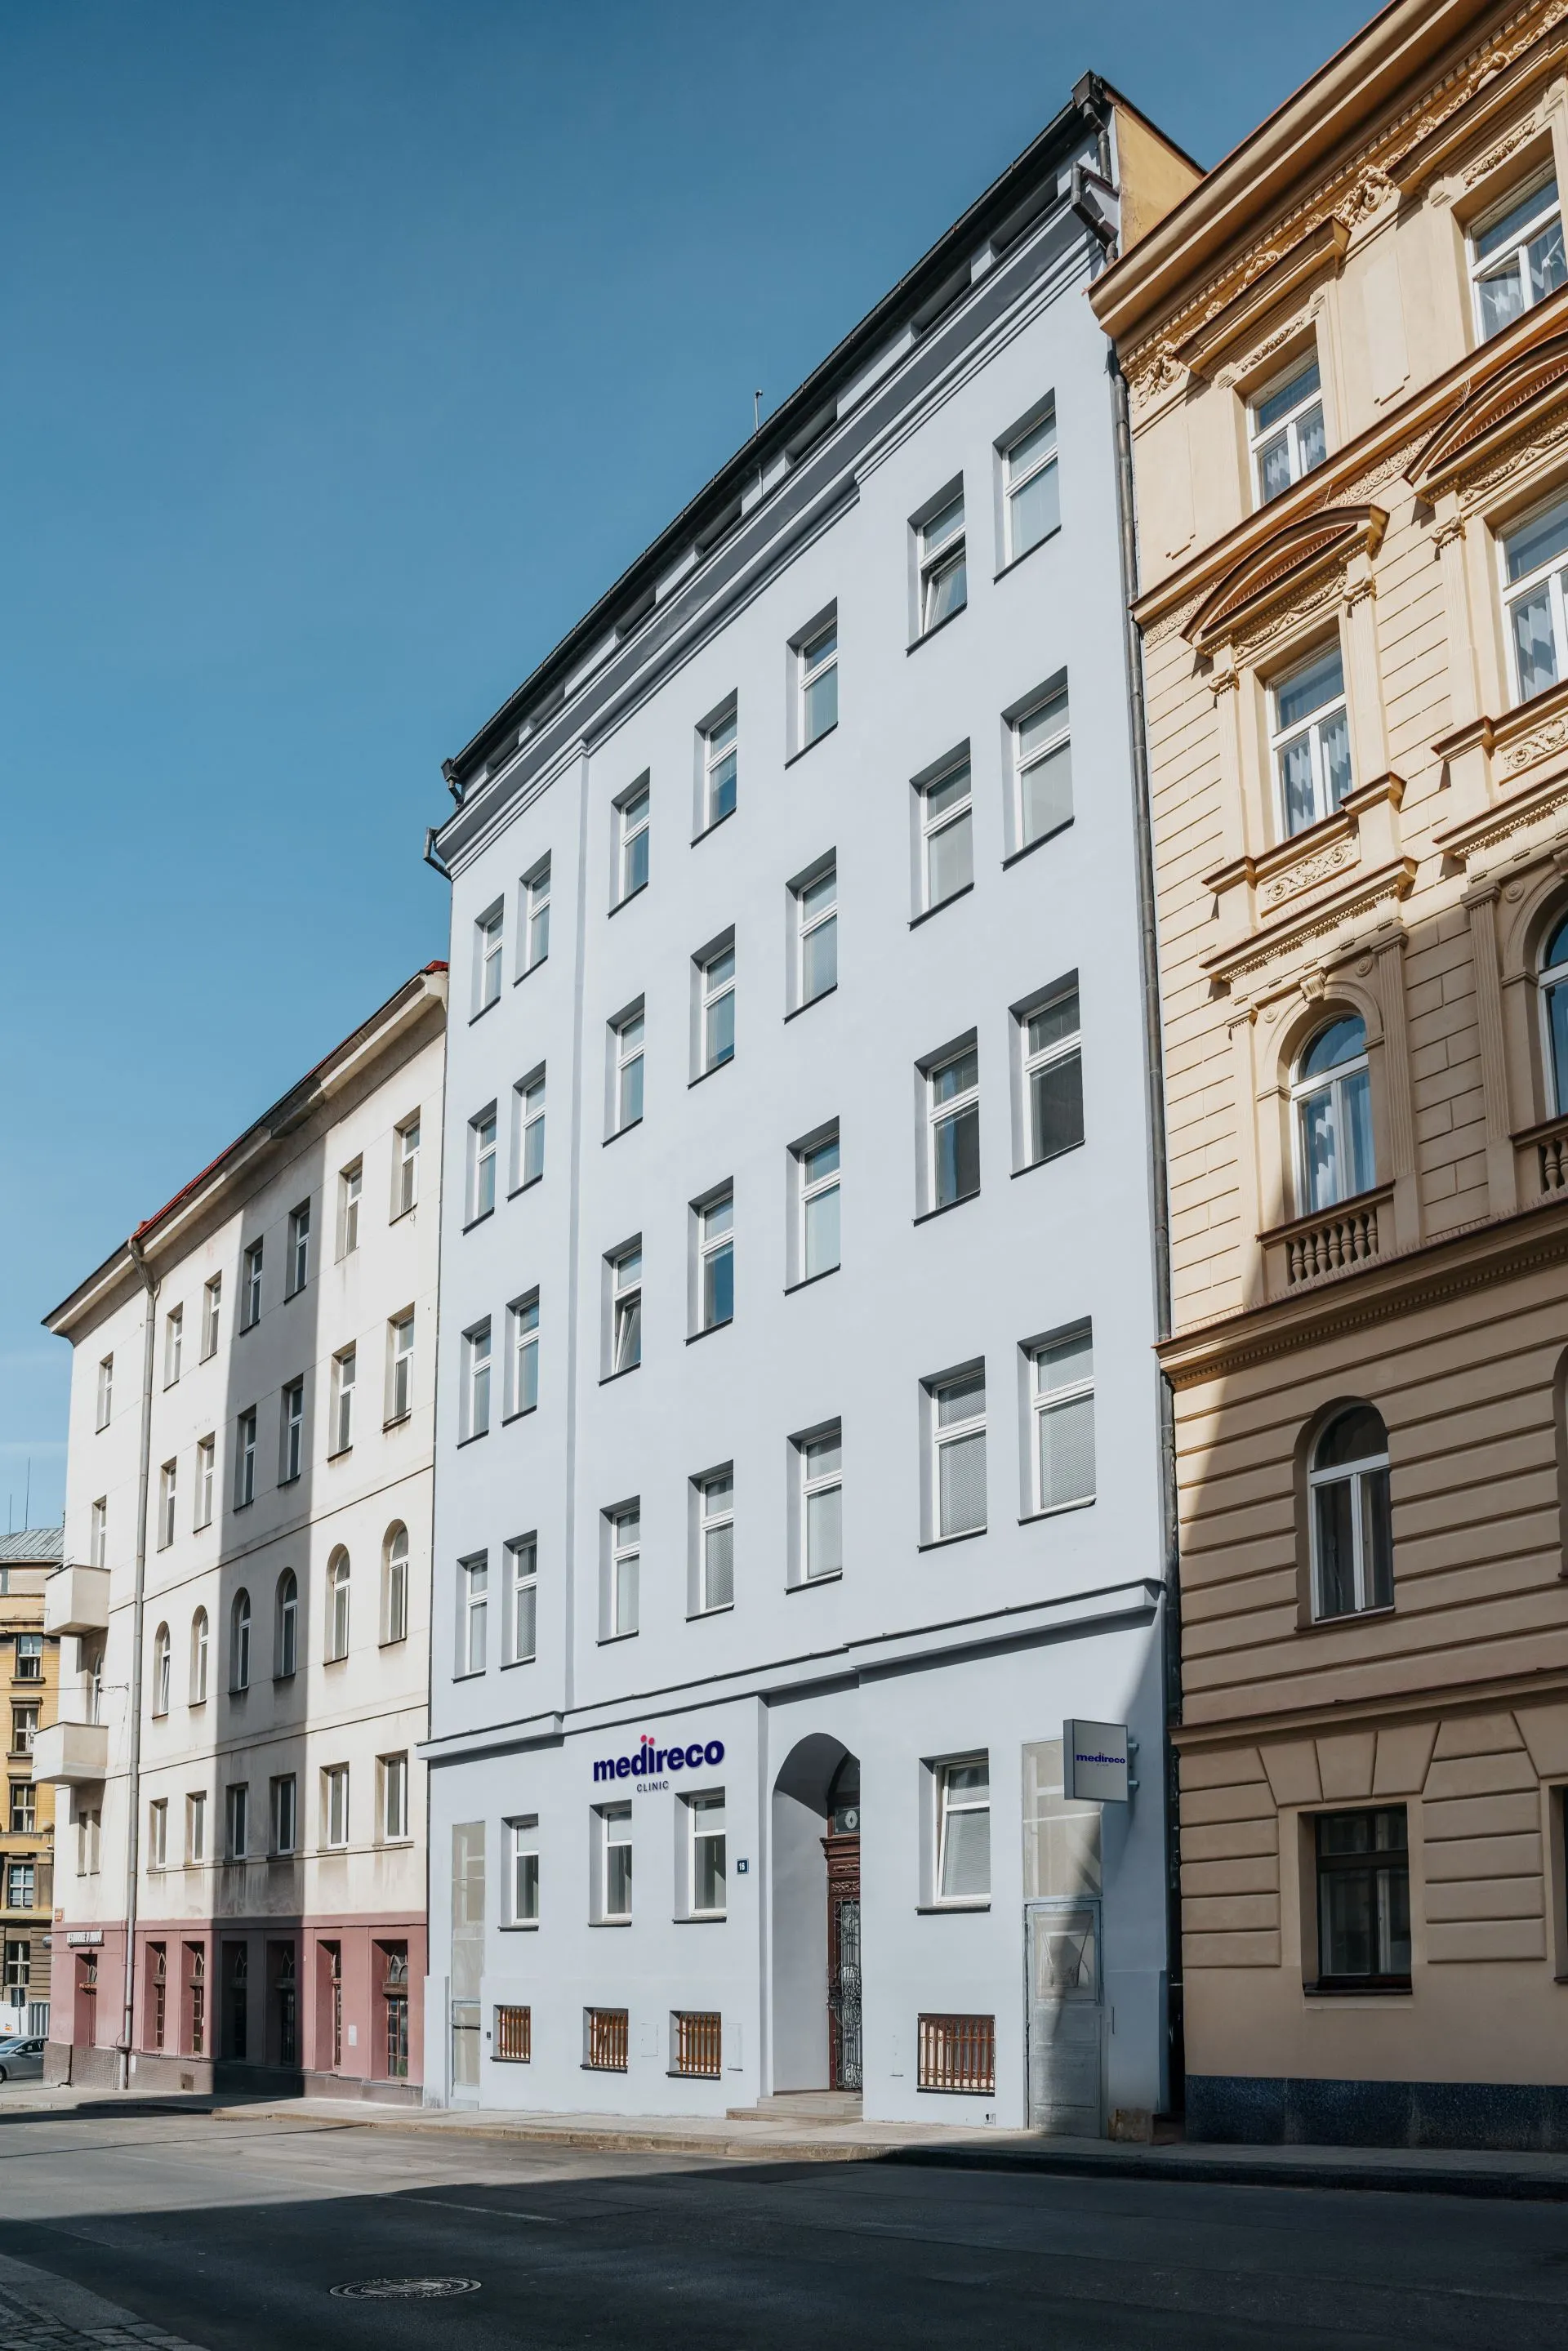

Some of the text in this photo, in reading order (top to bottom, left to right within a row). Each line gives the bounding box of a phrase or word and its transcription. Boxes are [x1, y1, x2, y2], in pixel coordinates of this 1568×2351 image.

[594, 1734, 724, 1782] medireco
[1076, 1752, 1125, 1764] medireco
[636, 1780, 670, 1792] CLINIC
[738, 1862, 746, 1871] 16
